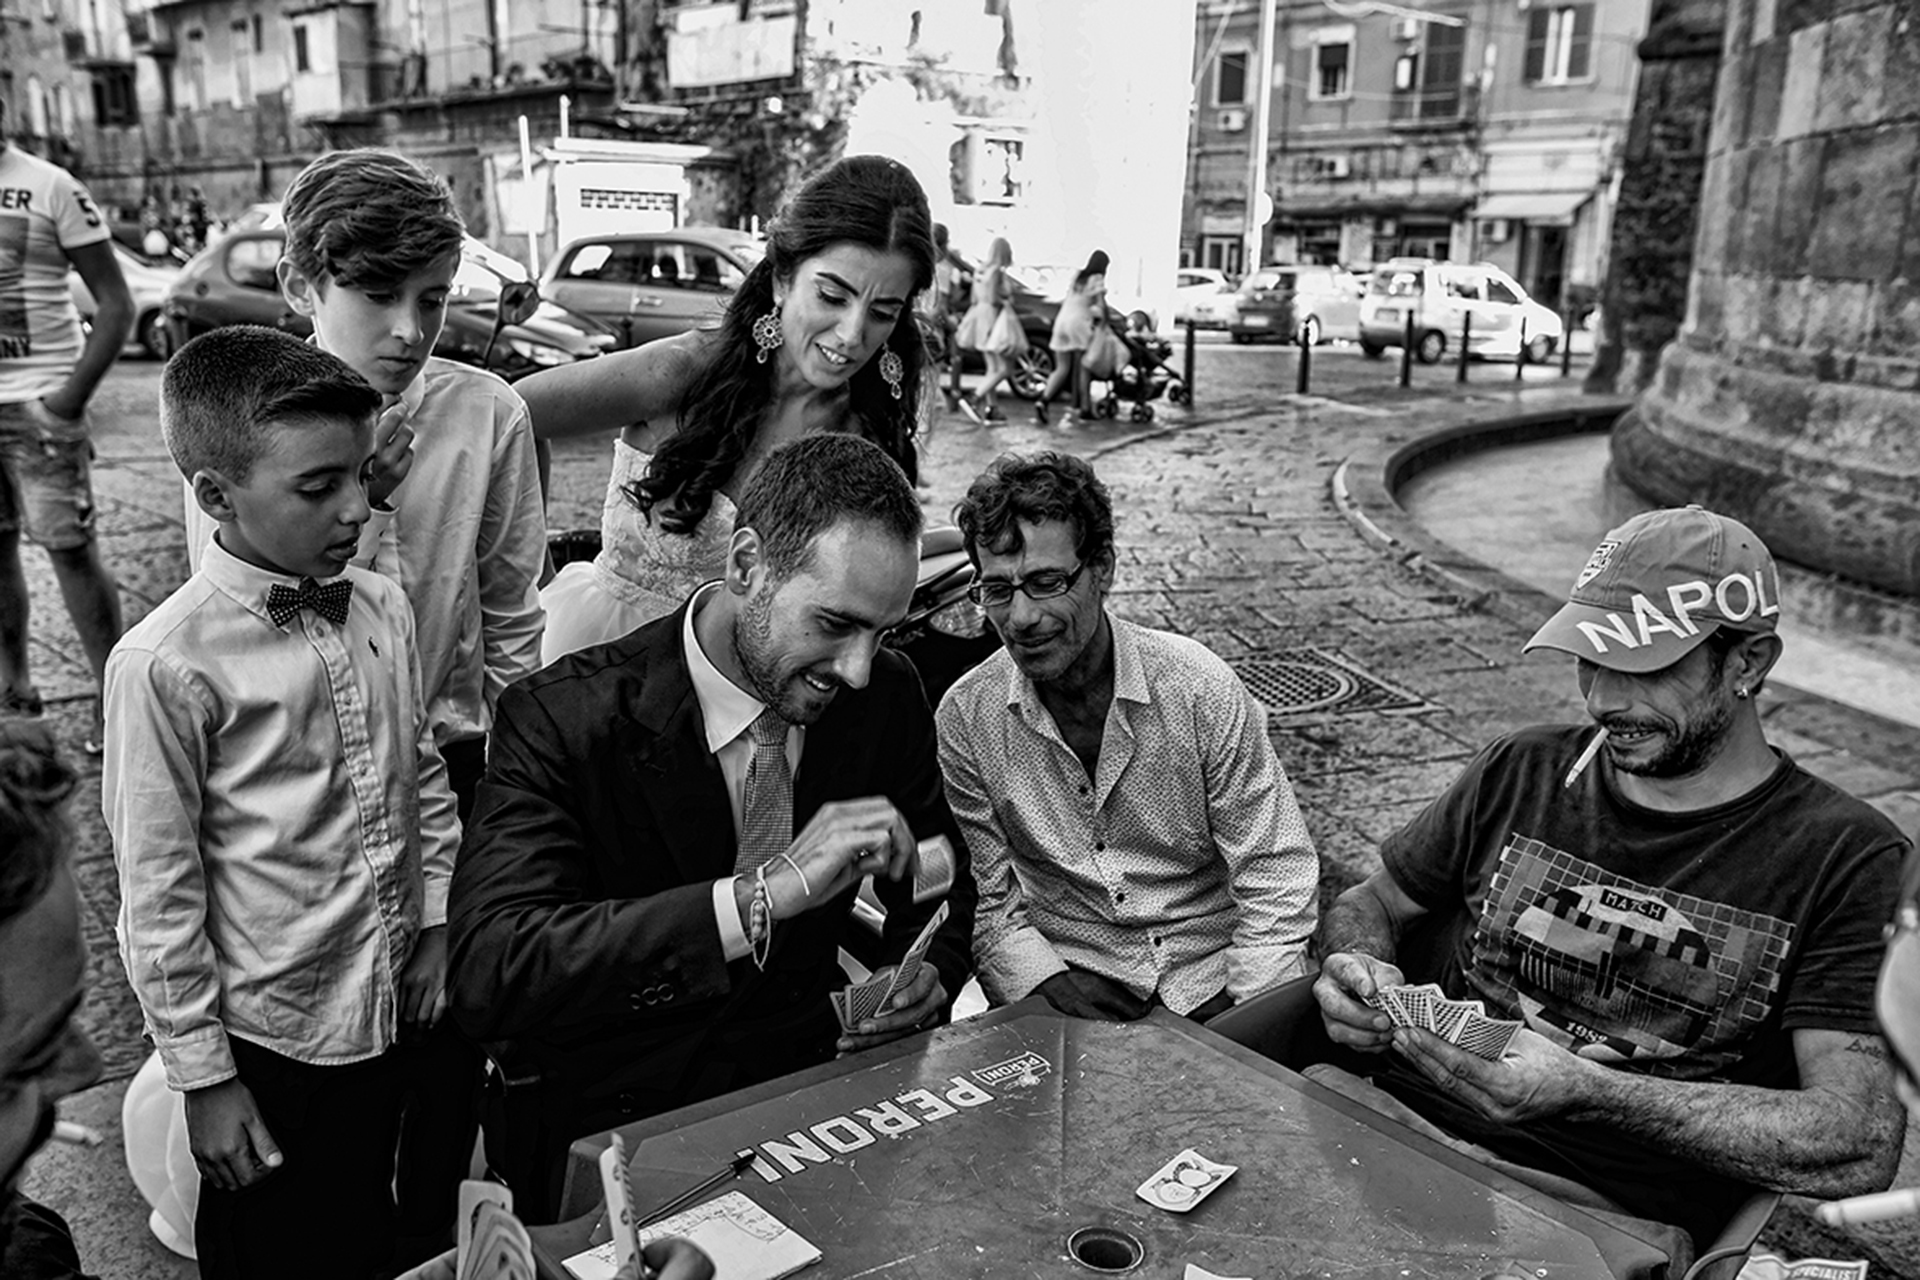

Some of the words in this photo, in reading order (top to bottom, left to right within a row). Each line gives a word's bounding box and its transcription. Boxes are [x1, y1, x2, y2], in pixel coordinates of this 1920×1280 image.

[0, 187, 32, 211] ER
[0, 336, 31, 358] NY
[1604, 892, 1662, 918] MATCH
[981, 1056, 1041, 1081] PERONI
[735, 1076, 995, 1184] PERONI
